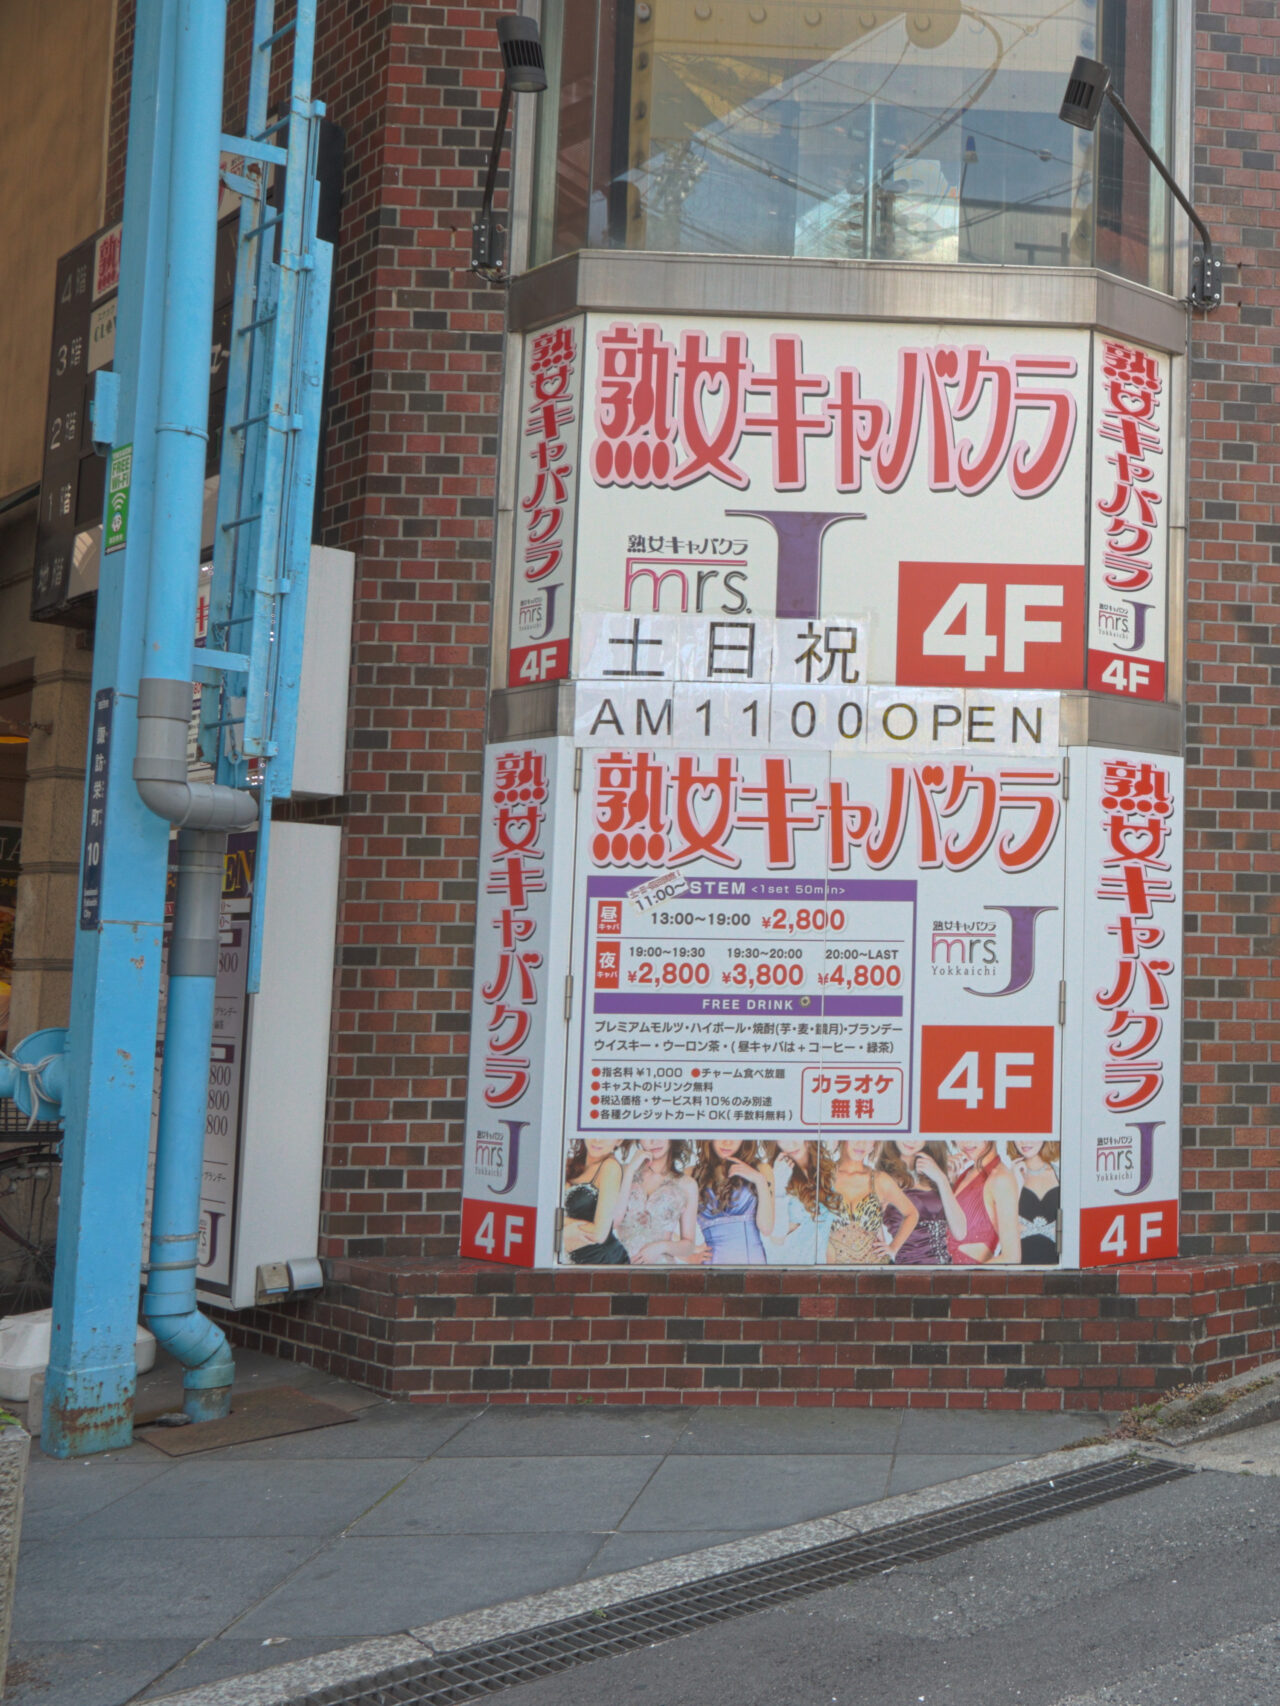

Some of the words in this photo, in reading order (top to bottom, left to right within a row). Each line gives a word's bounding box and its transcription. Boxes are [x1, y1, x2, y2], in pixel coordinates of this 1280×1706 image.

[591, 323, 1078, 498] 熟女キャバクラ
[521, 326, 576, 583] 熟女キャバクラ
[1097, 338, 1163, 592] 熟女キャバクラ
[627, 534, 749, 556] 熟女キャバクラ
[624, 558, 752, 614] mrs.
[529, 582, 564, 641] J
[921, 581, 1065, 673] 4F
[1113, 598, 1156, 651] J
[519, 647, 557, 681] 4F
[602, 617, 860, 685] 土日祝
[1101, 658, 1150, 693] 4F
[882, 702, 1043, 745] OPEN
[589, 749, 1065, 872] 熟女キャバクラ
[87, 842, 100, 866] 10
[689, 881, 746, 896] STEM
[481, 748, 548, 1109] 熟女キャバクラ
[600, 906, 618, 923] 昼
[761, 908, 846, 934] ¥2,800
[1094, 758, 1176, 1114] 熟女キャバクラ
[599, 951, 617, 969] 夜
[627, 962, 711, 988] ¥2,800
[721, 963, 805, 989] ¥3,800
[817, 964, 902, 989] ¥4,800
[931, 965, 997, 976] Yokkaichi
[963, 905, 1059, 998] J
[702, 999, 740, 1010] FREE
[747, 999, 794, 1011] DRINK
[601, 1081, 713, 1093] キャストのドリンク無料
[636, 1067, 683, 1078] ¥1,000
[700, 1068, 786, 1079] チャーム食べ放題
[811, 1074, 894, 1094] カラオケ
[937, 1051, 1035, 1110] 4F
[830, 1098, 875, 1120] 無料
[487, 1118, 531, 1196] J
[1114, 1120, 1166, 1198] J
[474, 1210, 523, 1259] 4F
[1100, 1210, 1163, 1258] 4F
